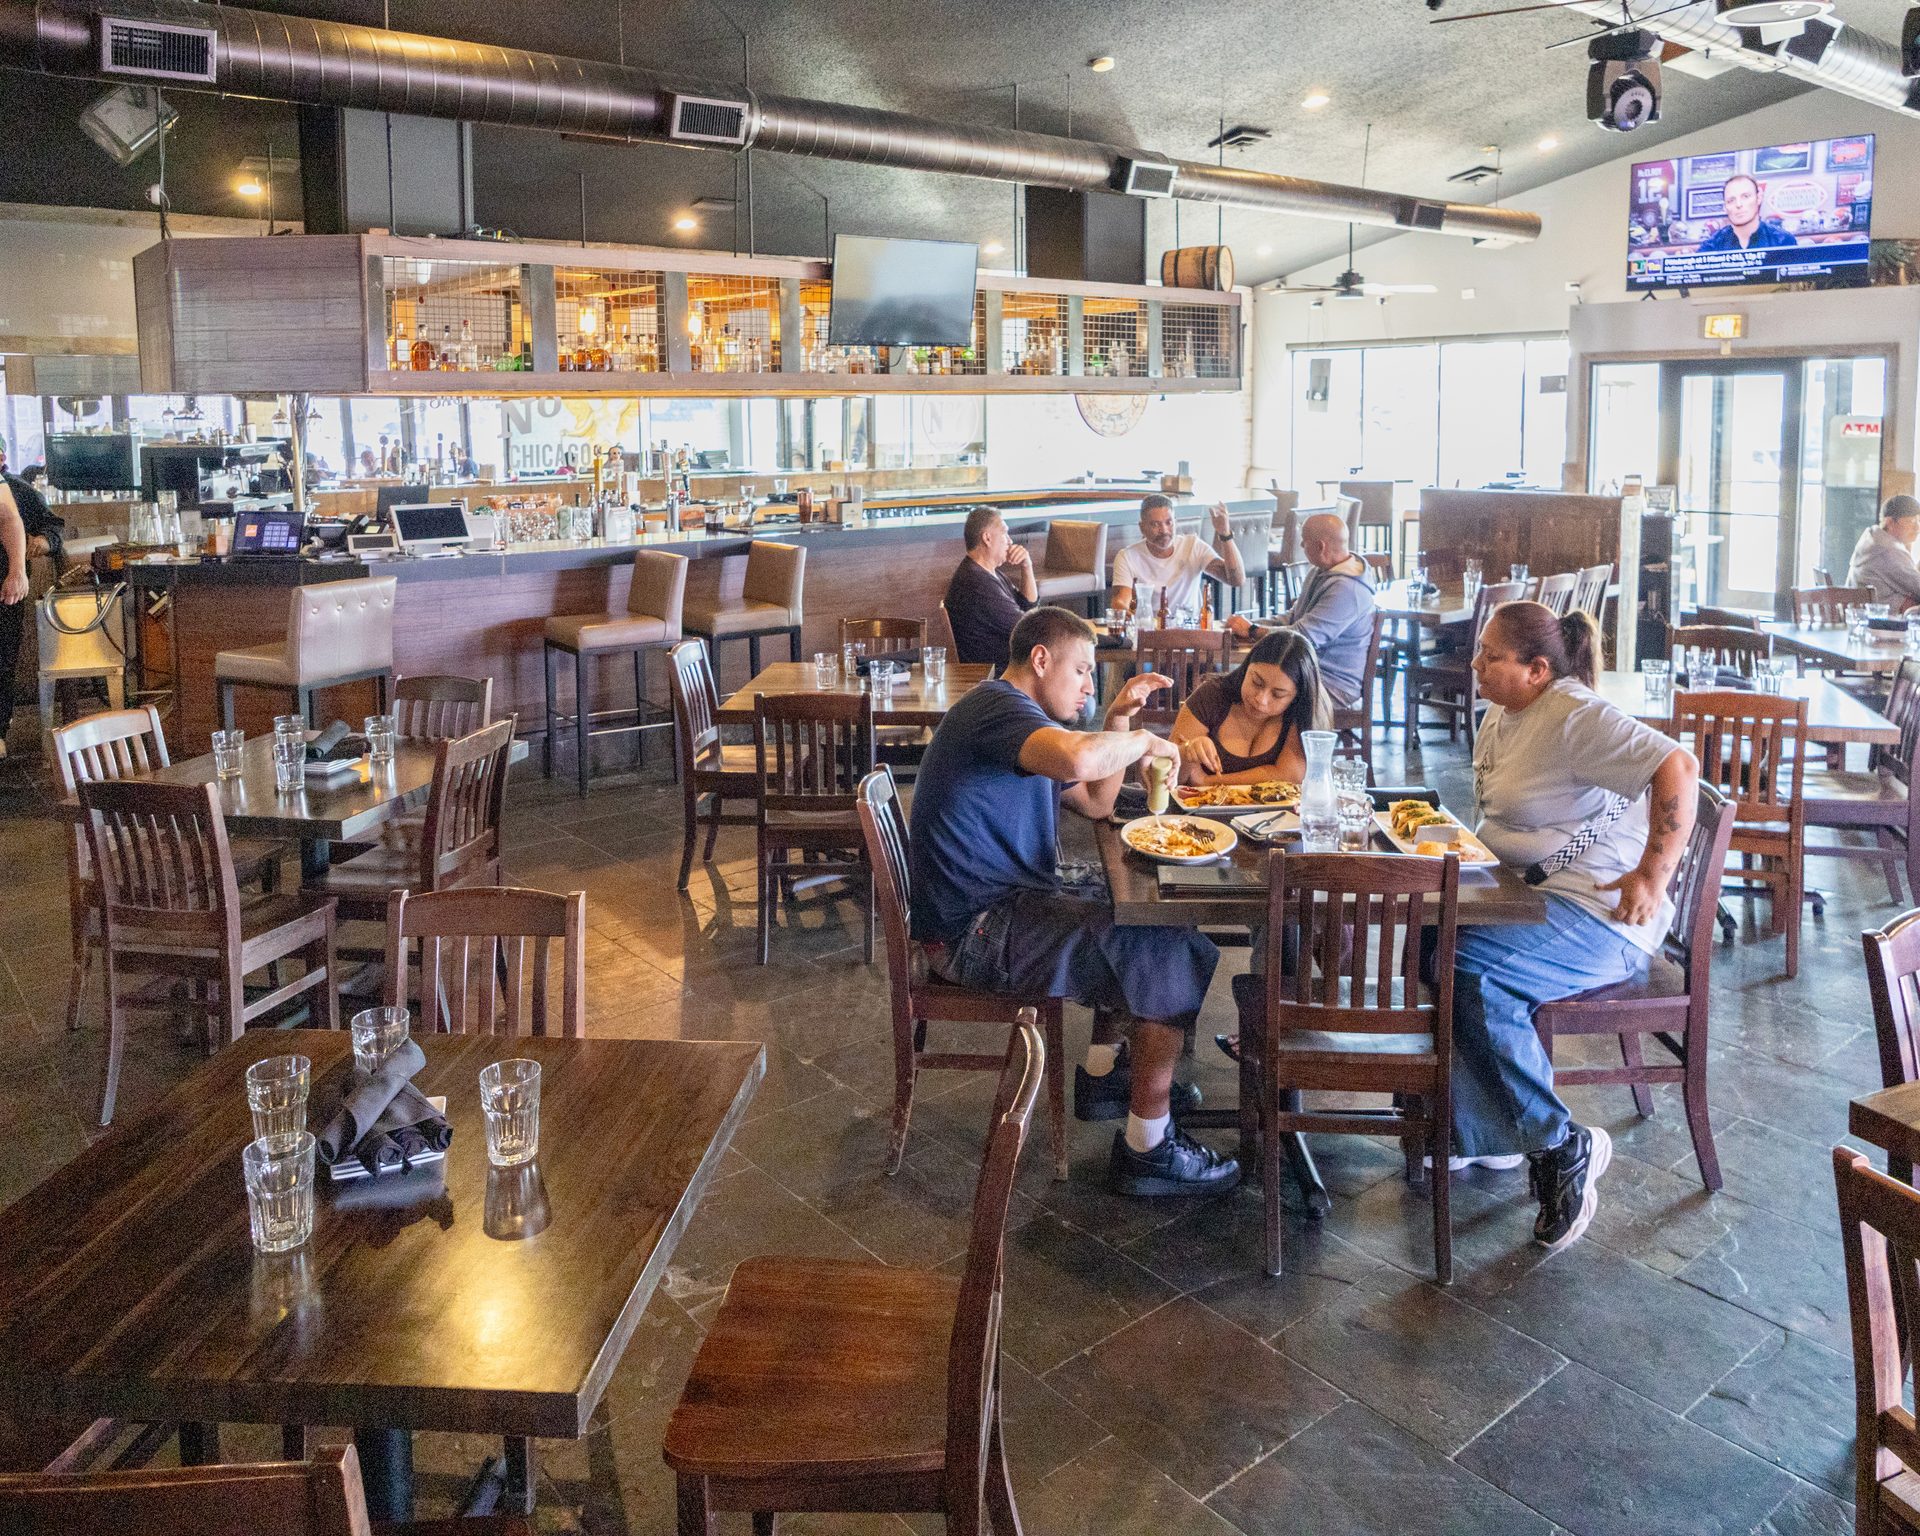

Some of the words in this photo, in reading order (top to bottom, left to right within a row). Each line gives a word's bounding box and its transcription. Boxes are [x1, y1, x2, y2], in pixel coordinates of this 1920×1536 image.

[1638, 177, 1665, 204] 12
[1842, 423, 1879, 435] ATM
[510, 442, 592, 469] CHICAGO
